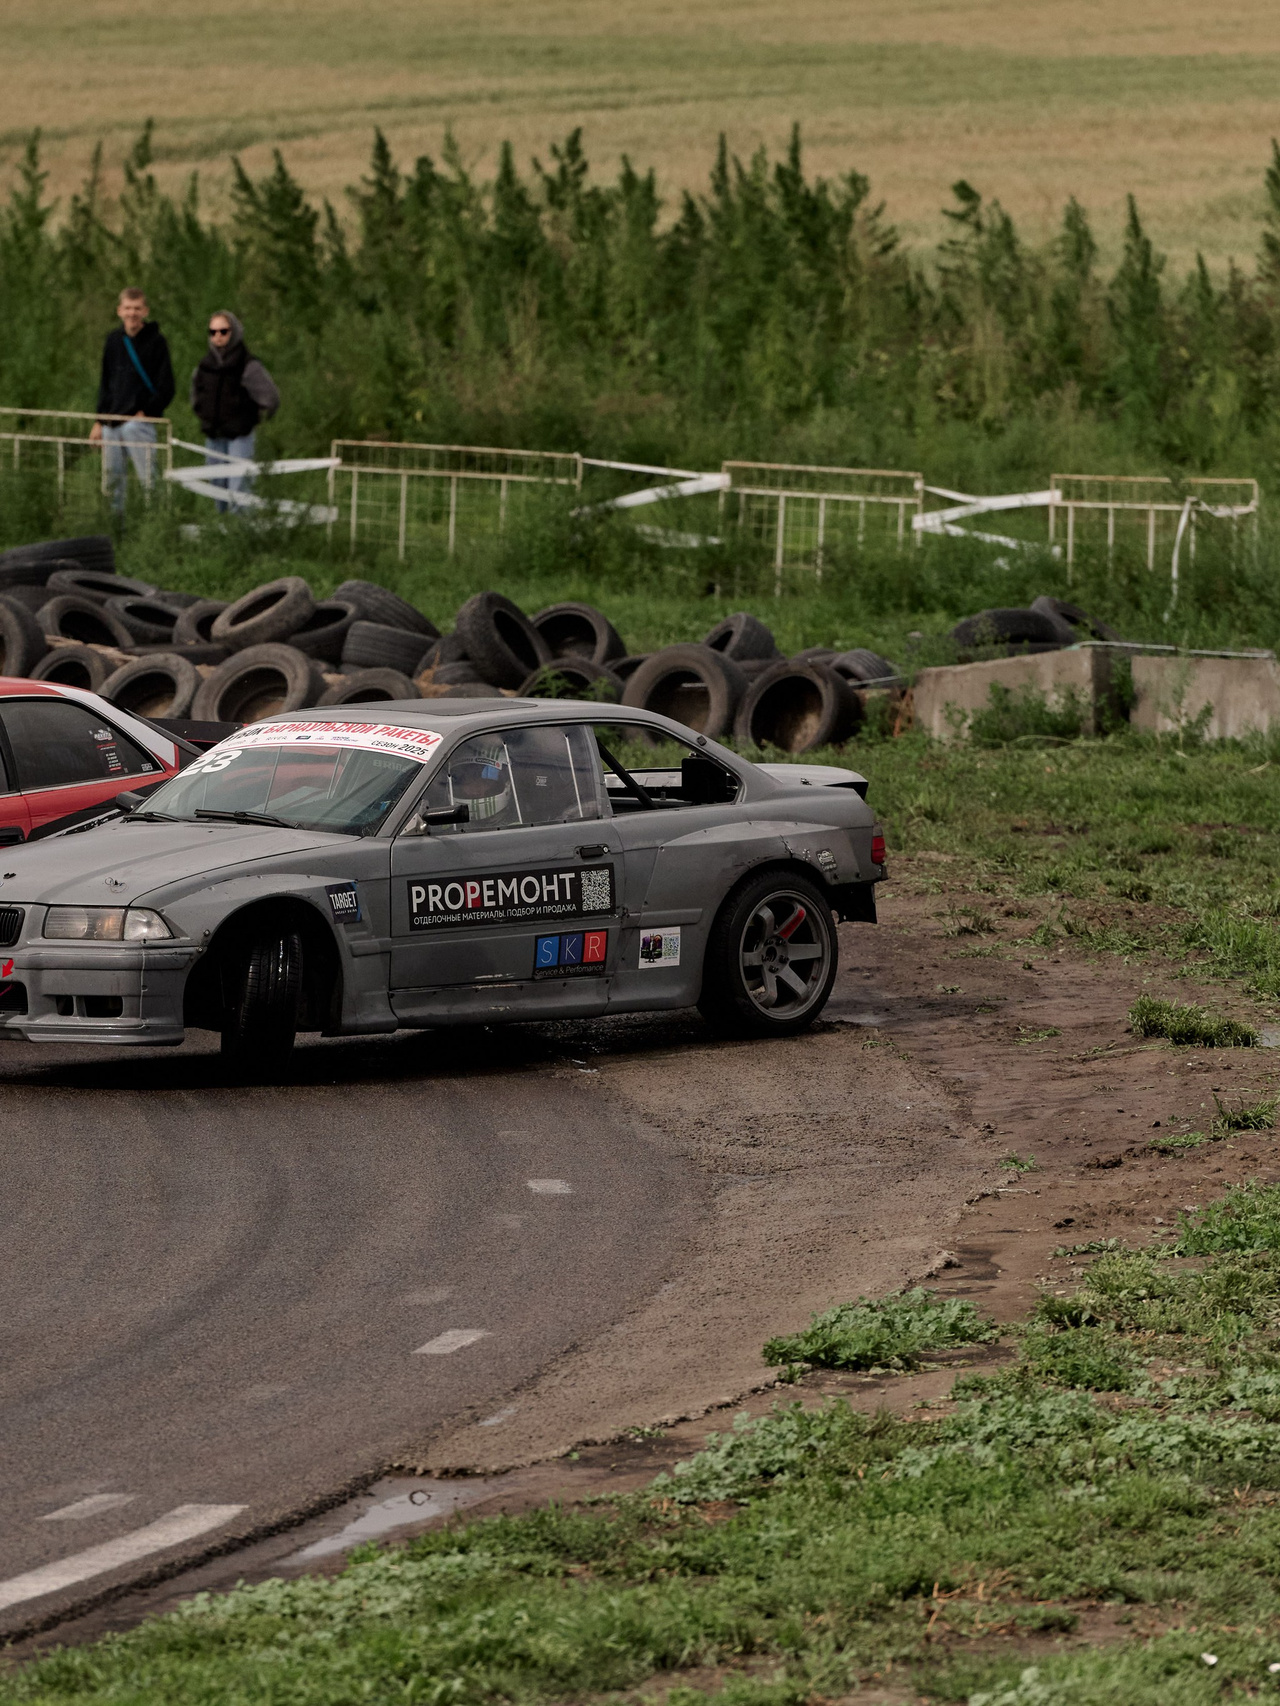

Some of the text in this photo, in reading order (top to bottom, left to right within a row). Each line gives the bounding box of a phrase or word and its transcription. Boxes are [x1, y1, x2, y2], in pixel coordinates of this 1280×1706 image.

[373, 726, 441, 746] РАКЕТЫ
[371, 740, 429, 755] СЕЗОН 2025
[179, 749, 242, 778] 23
[329, 891, 357, 909] TARGET
[413, 913, 461, 925] ОТДЕЛОЧНЫЕ
[506, 909, 535, 918] ПОДБОР
[535, 906, 542, 915] И
[543, 903, 577, 915] ПРОДАЖА
[541, 936, 600, 963] SKR
[534, 968, 558, 976] Service
[558, 967, 565, 975] &
